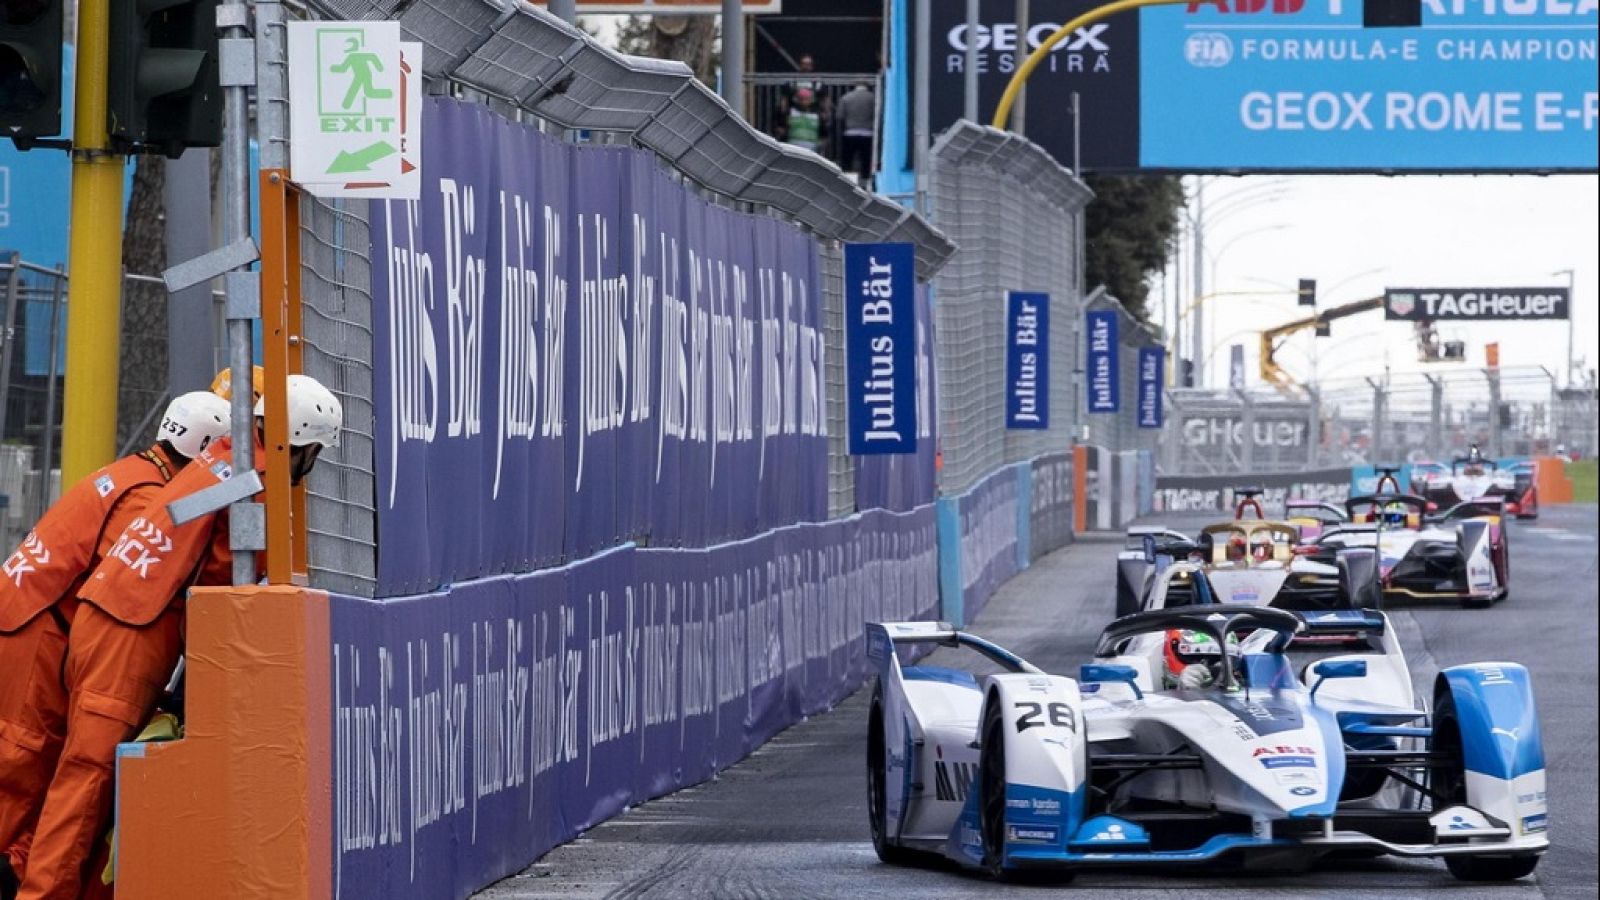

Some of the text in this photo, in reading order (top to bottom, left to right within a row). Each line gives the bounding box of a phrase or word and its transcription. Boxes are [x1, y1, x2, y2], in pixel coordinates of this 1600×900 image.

[947, 22, 1110, 51] GEOX
[1242, 39, 1419, 61] FORMULA-E
[1437, 39, 1597, 61] CHAMPION
[947, 53, 1110, 73] RESIRA
[320, 117, 395, 133] EXIT
[1240, 91, 1374, 131] GEOX
[1386, 92, 1523, 131] ROME
[440, 178, 486, 440] Bär
[1420, 293, 1562, 316] TAGHeuer
[862, 256, 902, 442] Julius Bär
[1014, 300, 1040, 422] Julius Bär
[1092, 318, 1114, 409] Julius Bär
[162, 417, 188, 437] 257
